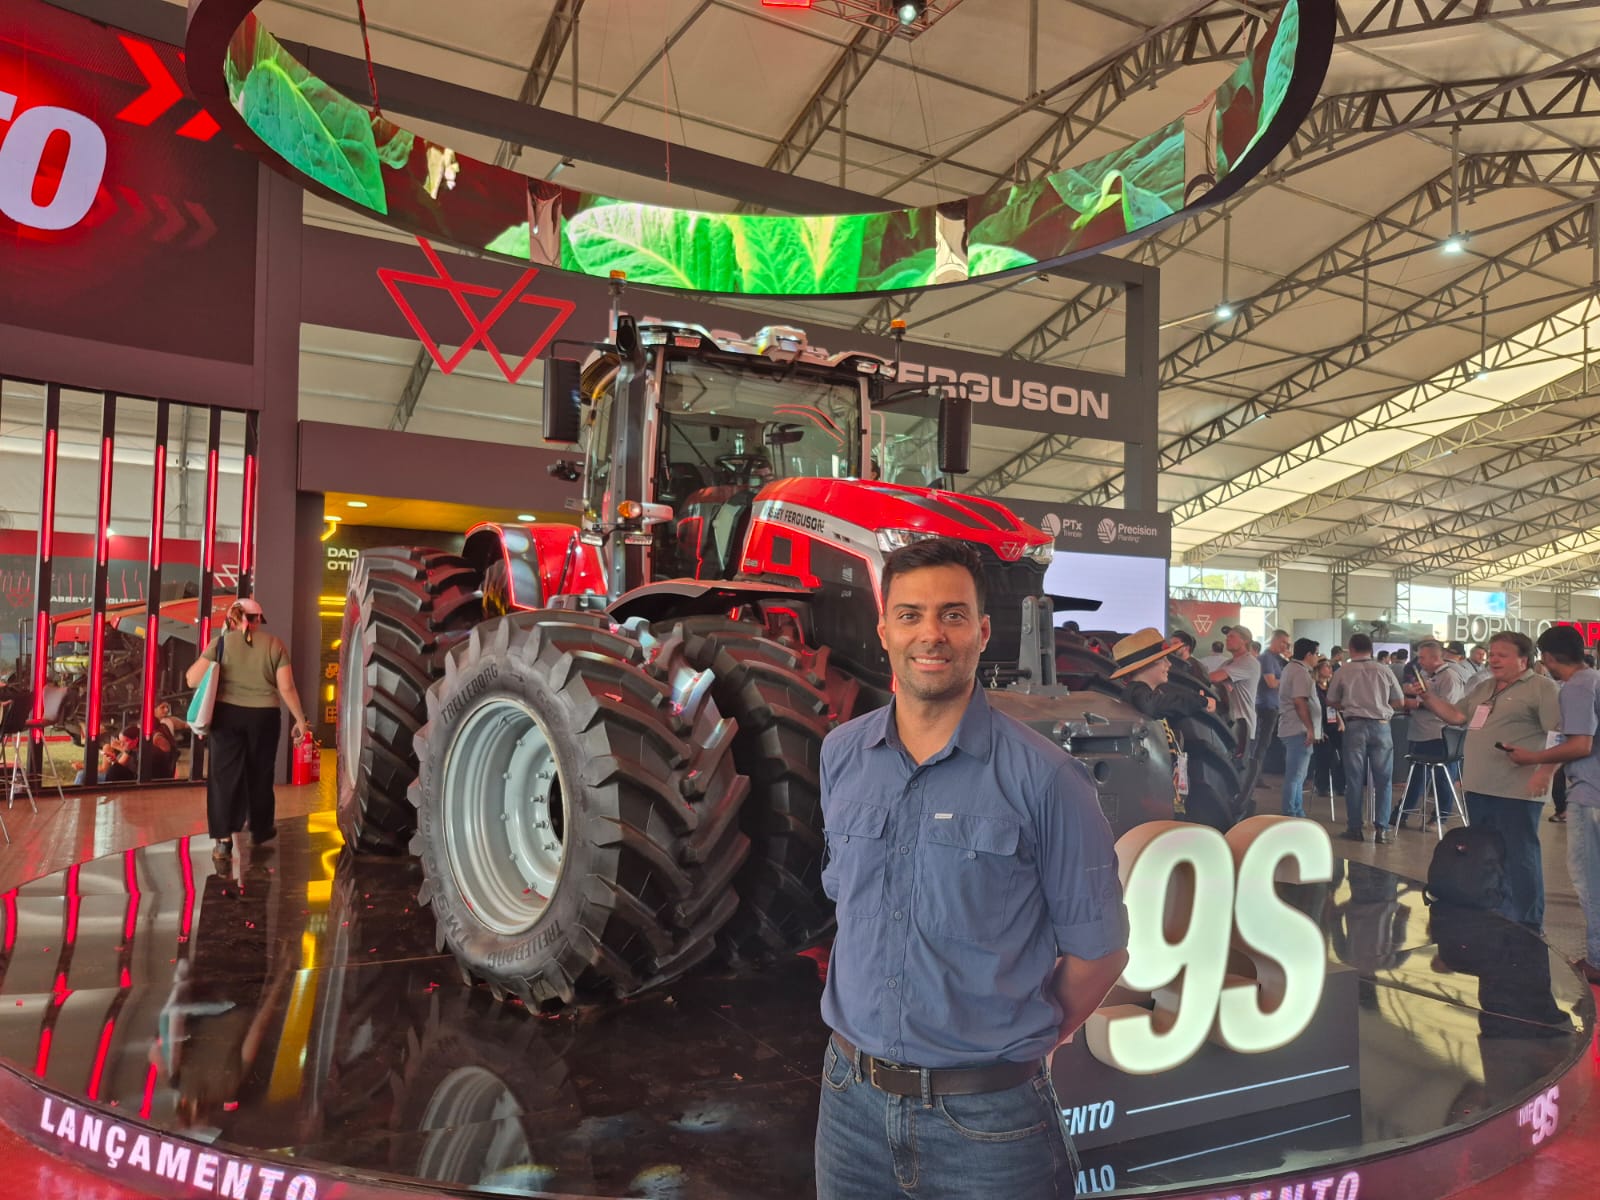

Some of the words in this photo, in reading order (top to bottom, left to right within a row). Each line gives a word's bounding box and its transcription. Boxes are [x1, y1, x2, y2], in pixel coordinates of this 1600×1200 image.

[897, 360, 1109, 419] ERGUSON
[785, 509, 825, 533] FERGUSON
[1062, 518, 1082, 531] PTx
[1118, 523, 1157, 537] Precision
[441, 662, 499, 725] TRELLEBORG
[1103, 817, 1334, 1076] 9S
[39, 1097, 317, 1200] LANÇAMENTO
